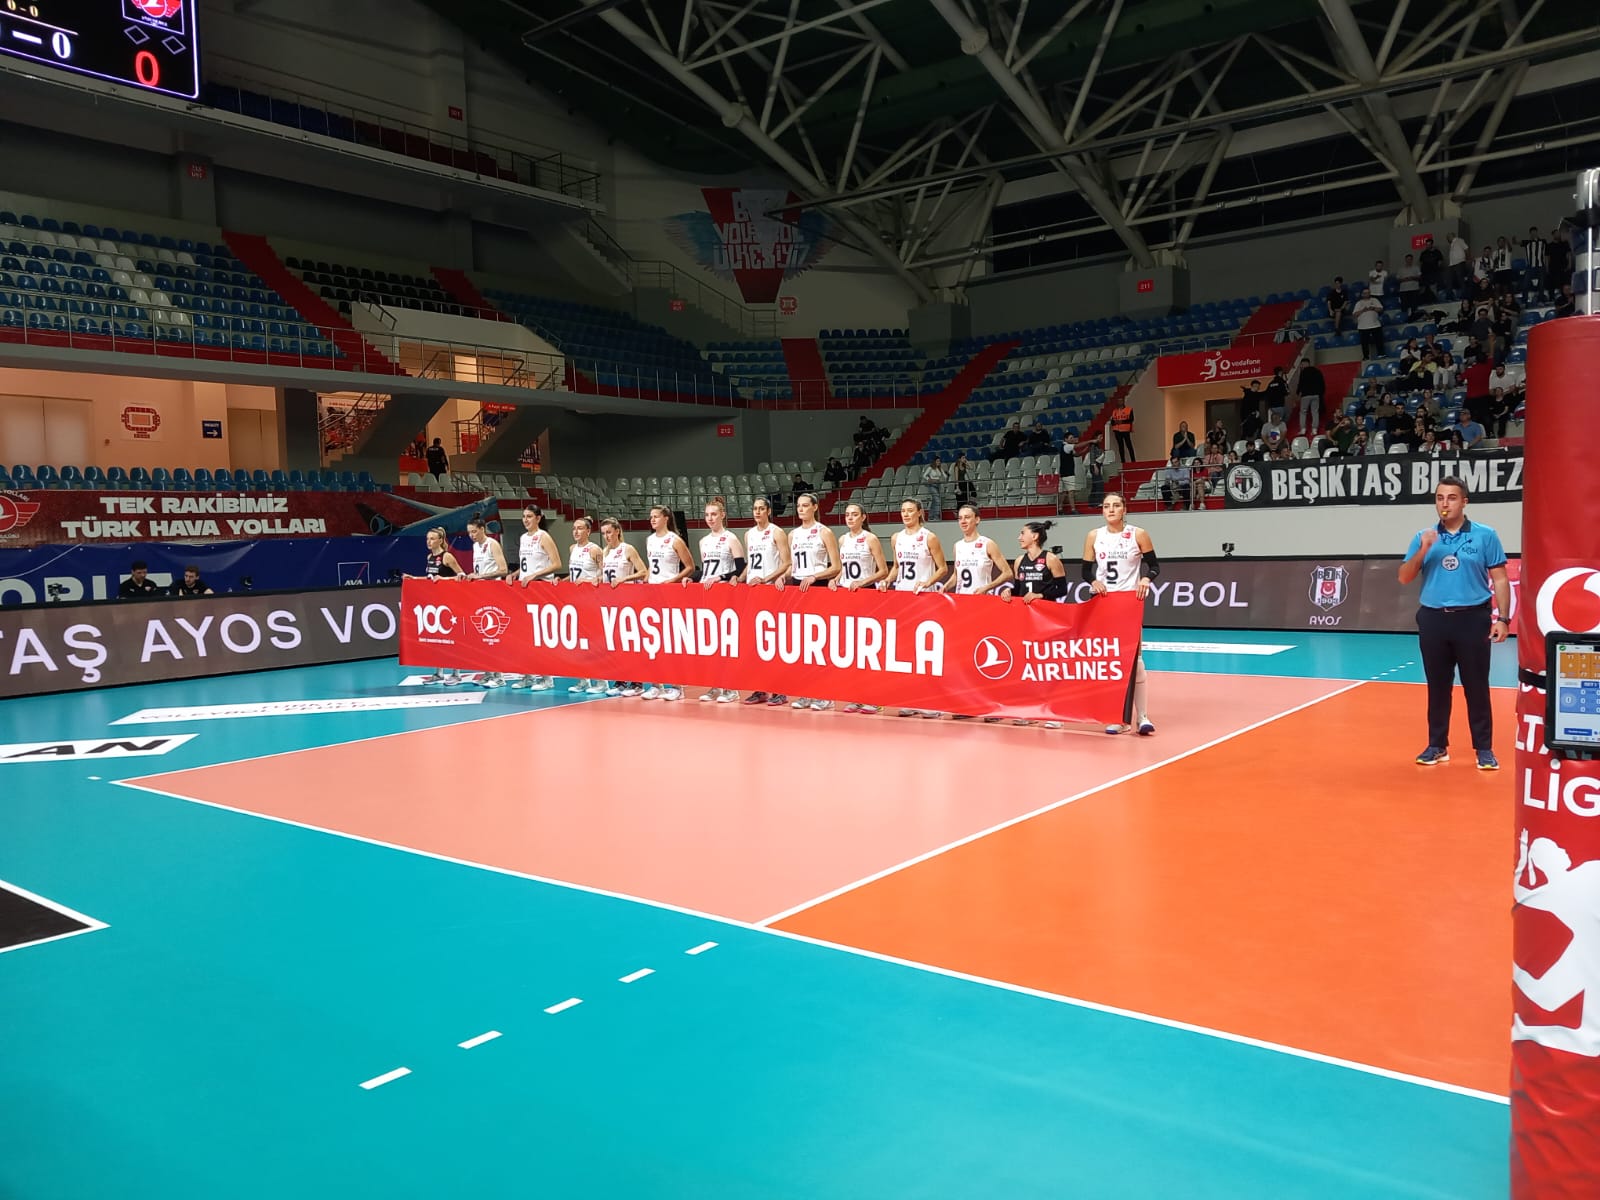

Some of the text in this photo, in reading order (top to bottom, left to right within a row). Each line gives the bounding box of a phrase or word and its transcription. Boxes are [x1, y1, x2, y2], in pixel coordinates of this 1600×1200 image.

[135, 51, 160, 87] 0
[1271, 459, 1402, 504] BEŞİKTAŞ
[100, 493, 289, 514] TEK RAKİBİMİZ
[61, 516, 327, 538] TÜRK HAVA YOLLARI
[521, 557, 528, 572] 6
[652, 559, 660, 575] 3
[703, 559, 720, 576] 77
[750, 553, 762, 570] 12
[794, 551, 807, 569] 11
[570, 567, 582, 582] 17
[843, 561, 861, 579] 10
[899, 561, 916, 580] 13
[961, 568, 972, 588] 9
[1106, 561, 1119, 581] 5
[1310, 615, 1342, 626] AYOS
[0, 602, 402, 683] AŞ AYOS VO
[527, 604, 945, 676] 100. YAŞINDA GURURLA
[1022, 637, 1120, 660] TURKISH
[1021, 660, 1123, 682] AIRLINES
[2, 739, 172, 758] AN
